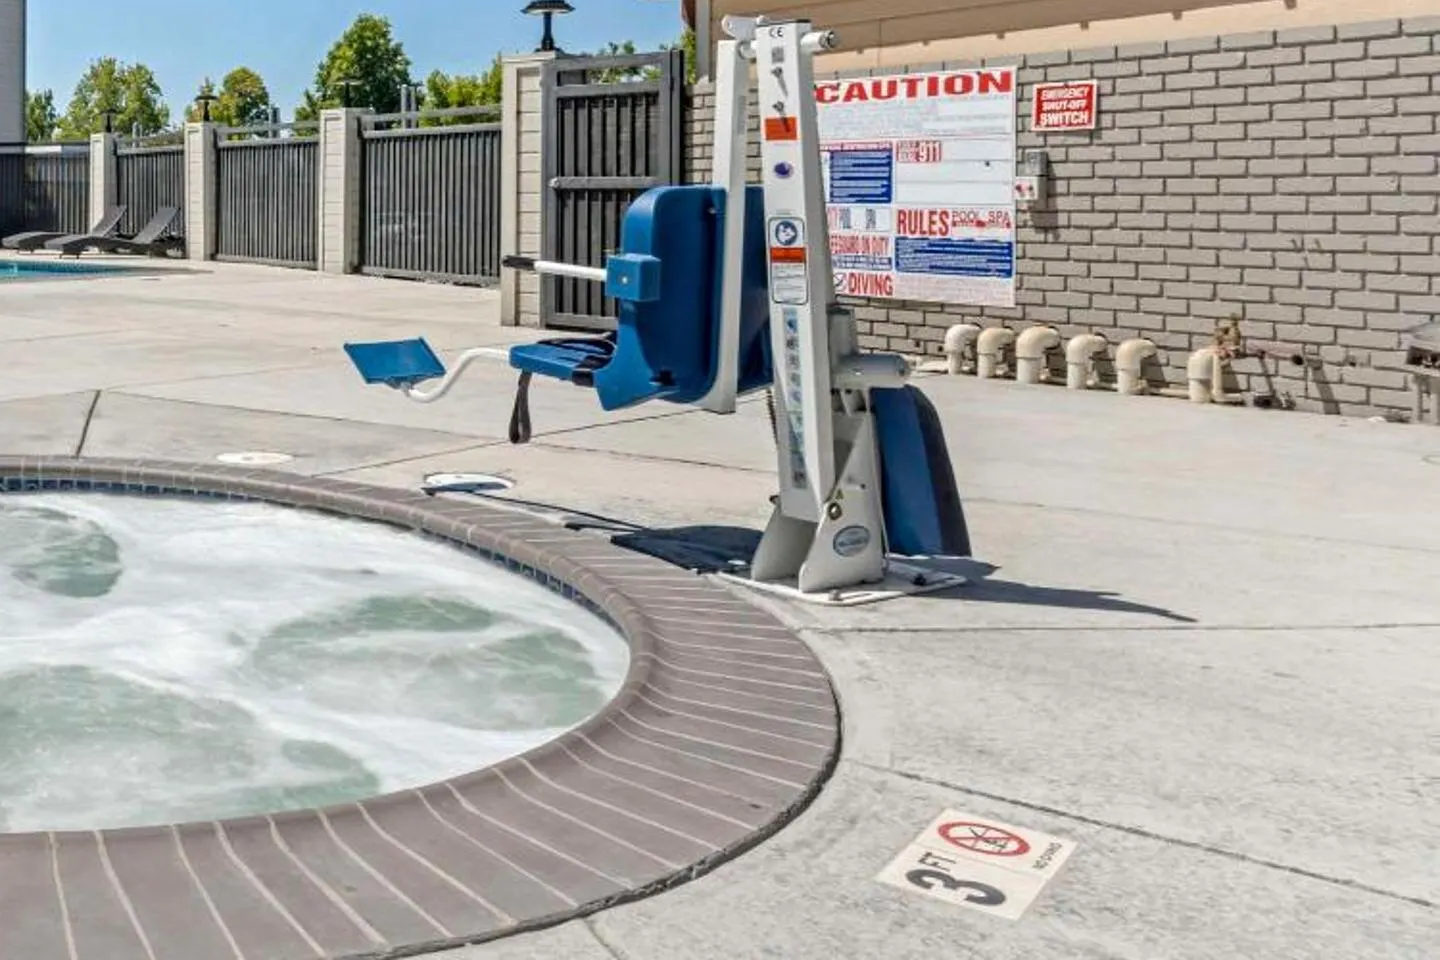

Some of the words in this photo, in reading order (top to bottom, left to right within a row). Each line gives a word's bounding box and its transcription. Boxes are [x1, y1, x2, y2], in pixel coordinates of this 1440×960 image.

[814, 71, 1012, 104] CAUTION
[1041, 100, 1087, 112] SHUT-OFF
[1040, 111, 1089, 126] SWITCH
[917, 141, 941, 161] 911
[897, 209, 950, 236] RULES
[848, 272, 893, 296] DIVING
[917, 851, 957, 872] FT
[905, 868, 1007, 907] 3
